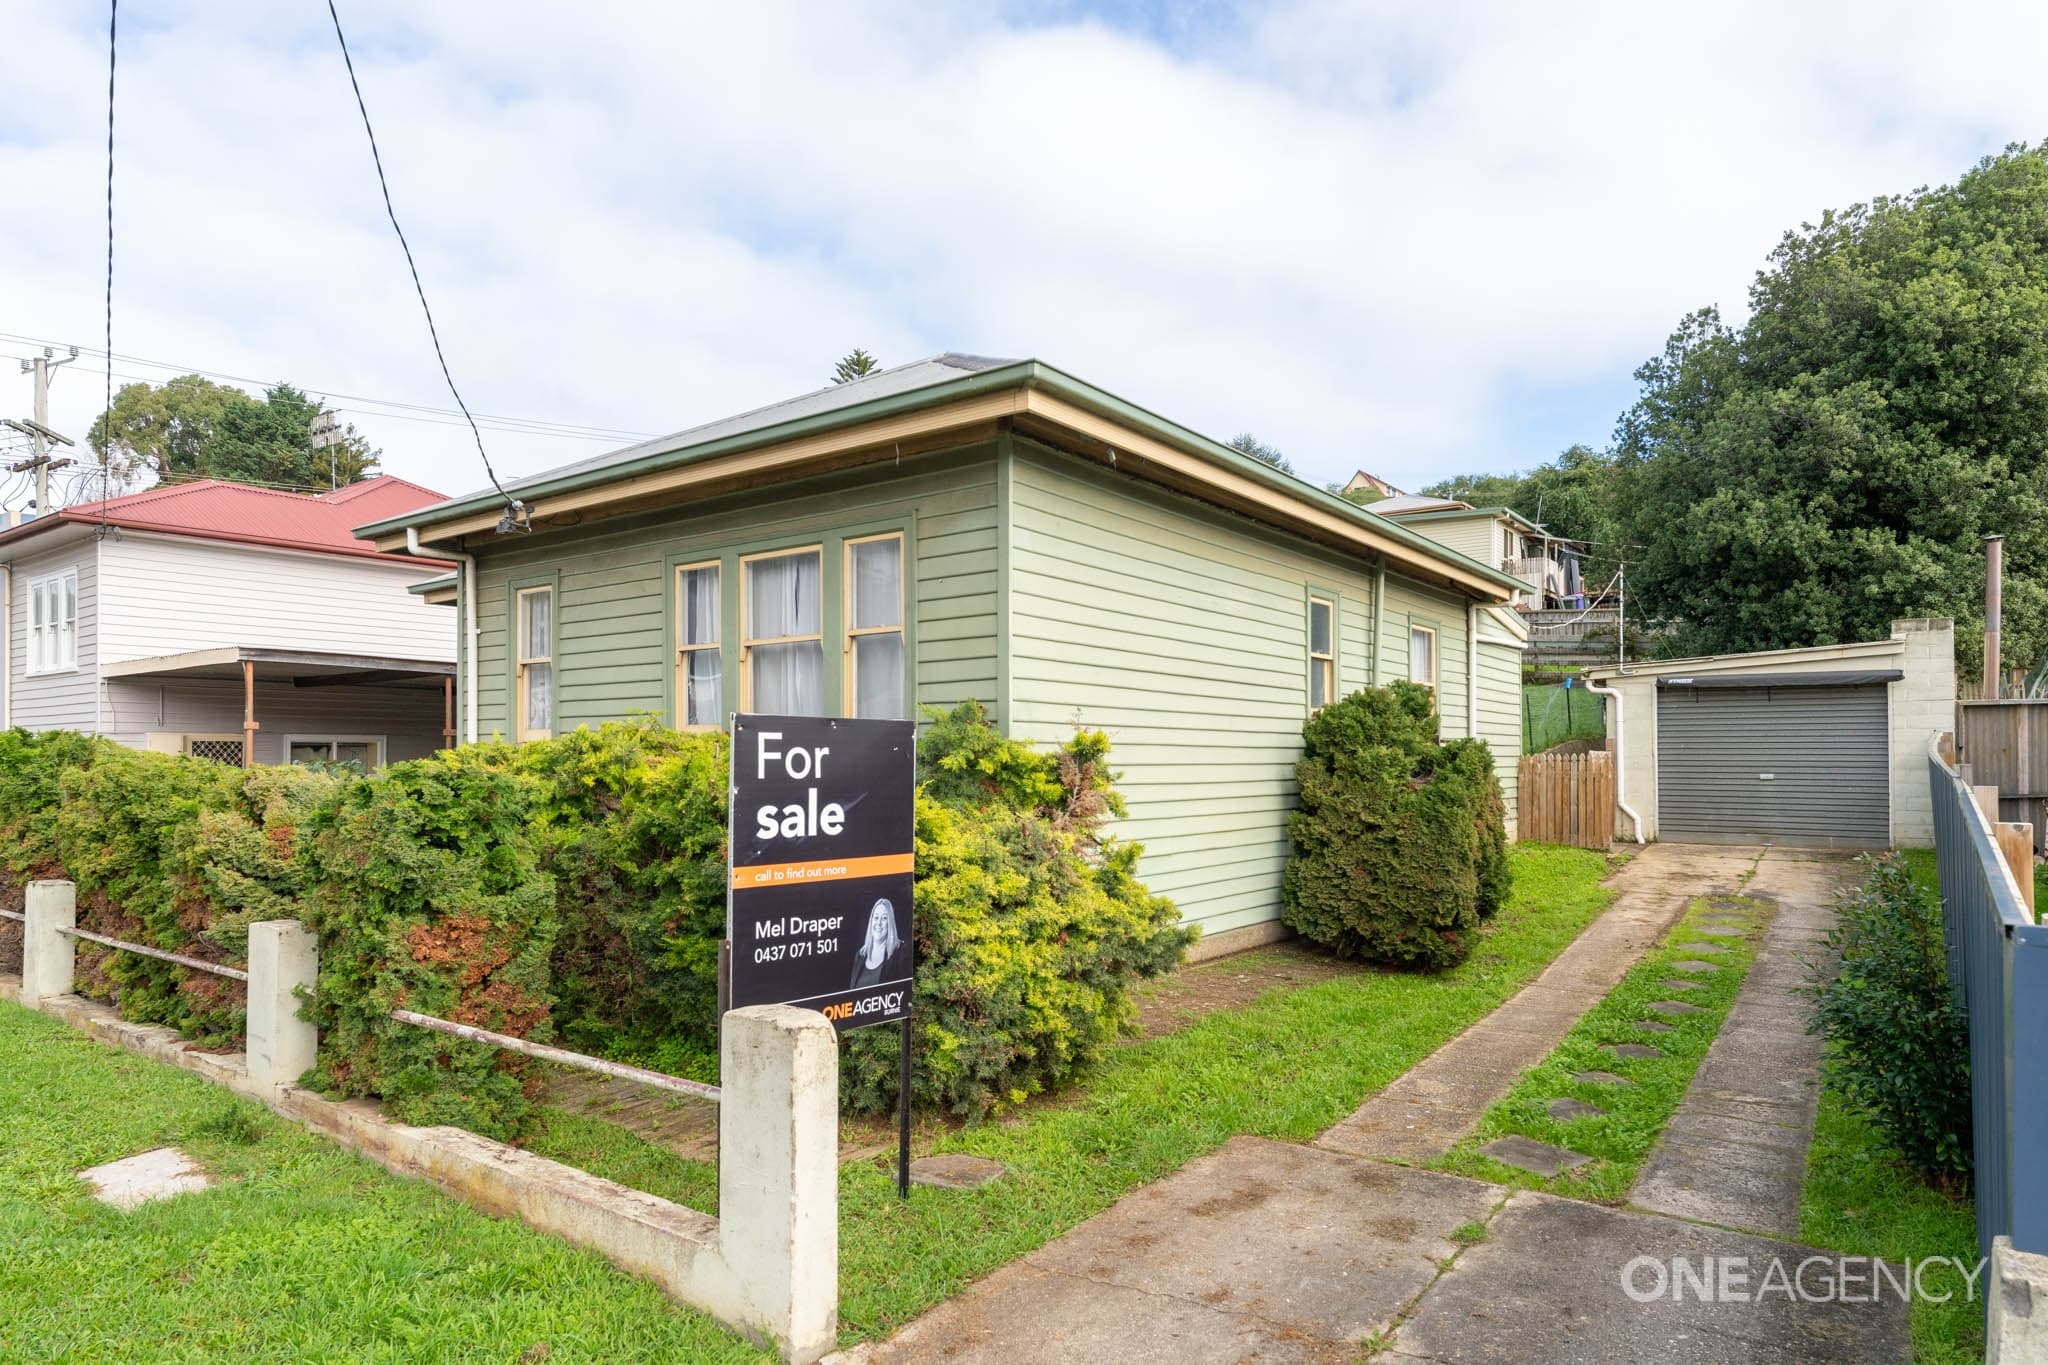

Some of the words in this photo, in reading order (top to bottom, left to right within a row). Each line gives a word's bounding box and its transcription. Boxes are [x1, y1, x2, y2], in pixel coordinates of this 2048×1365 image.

[757, 731, 830, 780] For
[756, 787, 845, 840] sale
[754, 869, 772, 882] call
[774, 870, 785, 881] to
[787, 867, 805, 880] find
[807, 868, 822, 878] out
[824, 866, 847, 876] more
[755, 917, 786, 940] Mel
[790, 916, 844, 938] Draper
[754, 944, 787, 964] 0437
[789, 941, 812, 958] 071
[817, 937, 838, 954] 501
